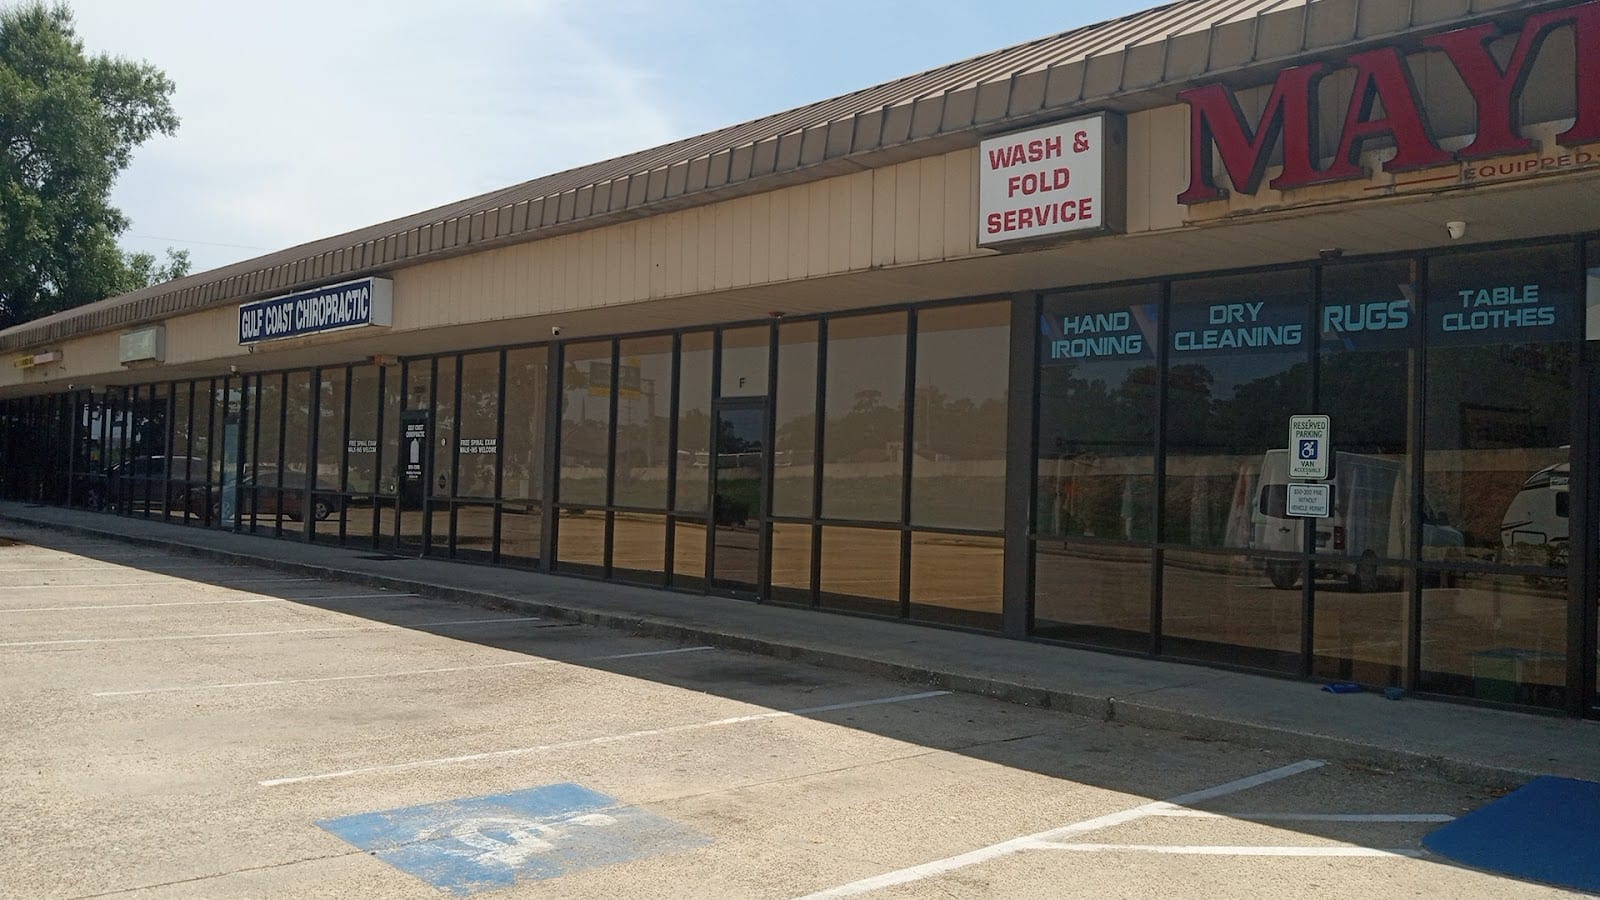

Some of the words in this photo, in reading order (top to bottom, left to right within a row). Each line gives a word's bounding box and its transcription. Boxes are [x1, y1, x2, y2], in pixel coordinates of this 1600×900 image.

[989, 135, 1062, 170] WASH
[1073, 130, 1089, 154] &
[1008, 167, 1070, 198] FOLD
[987, 197, 1092, 234] SERVICE
[1458, 284, 1539, 308] TABLE
[241, 308, 263, 339] GULF
[265, 302, 293, 335] COAST
[295, 286, 368, 330] CHIROPRACTIC
[1063, 311, 1130, 335] HAND
[1209, 301, 1264, 324] DRY
[1323, 300, 1410, 333] RUGS
[1442, 306, 1555, 332] CLOTHES
[1051, 334, 1142, 359] IRONING
[1174, 324, 1302, 351] CLEANING
[739, 377, 746, 389] F
[1293, 421, 1326, 430] RESERVED
[1296, 430, 1322, 438] PARKING
[459, 446, 478, 454] WALK-INS
[478, 446, 497, 454] WELCOME
[484, 438, 497, 446] EXAM
